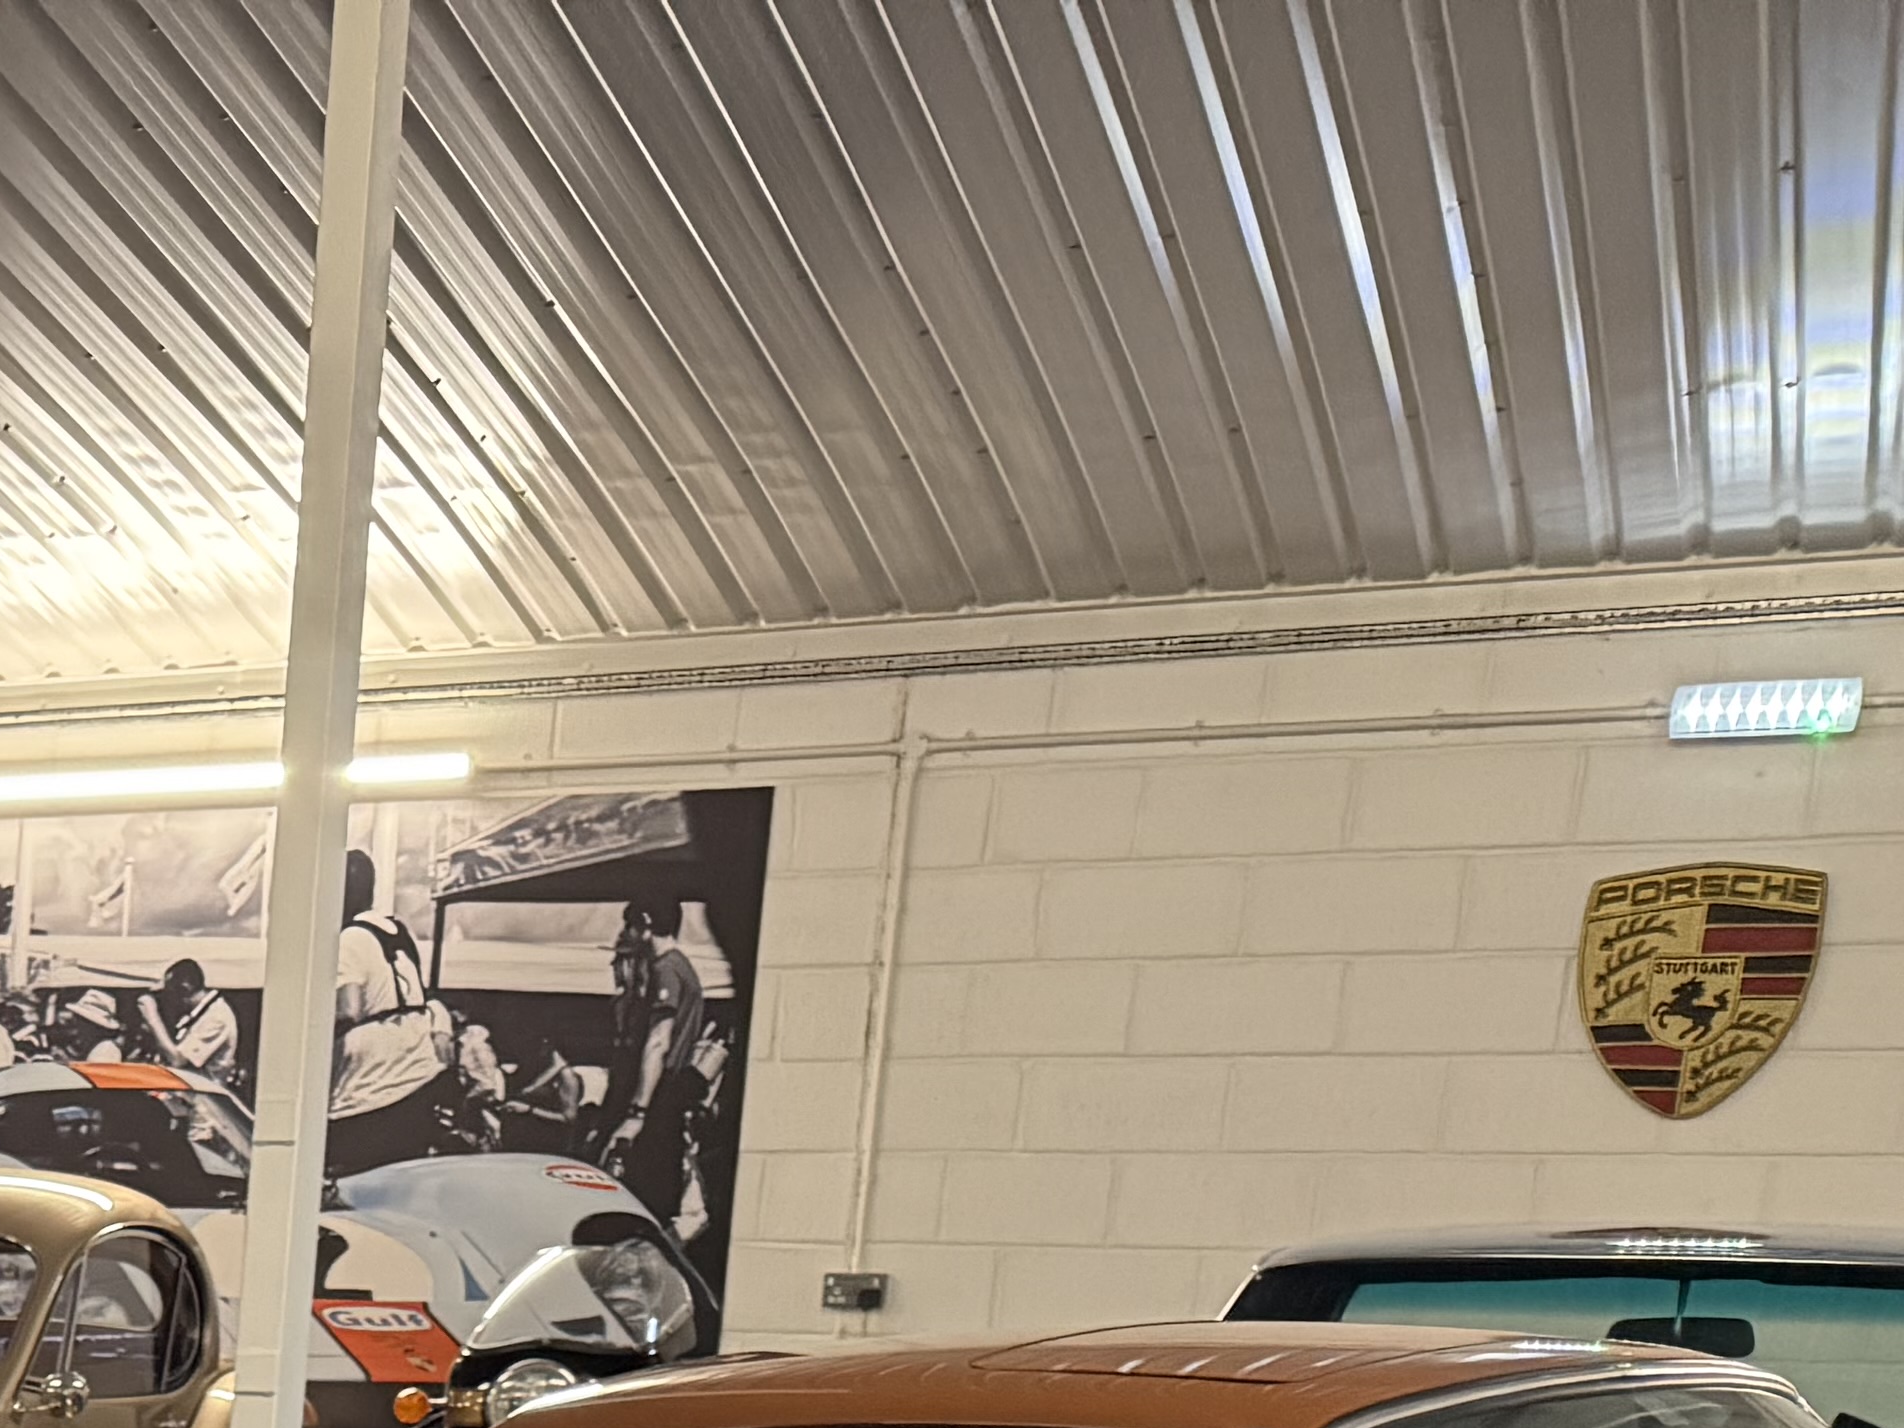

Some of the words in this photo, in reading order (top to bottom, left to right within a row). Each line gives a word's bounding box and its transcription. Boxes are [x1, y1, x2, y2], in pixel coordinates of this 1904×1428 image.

[1596, 874, 1820, 912] PORSCHE
[1652, 960, 1739, 976] STUTTGART
[328, 1310, 424, 1328] Gulf
